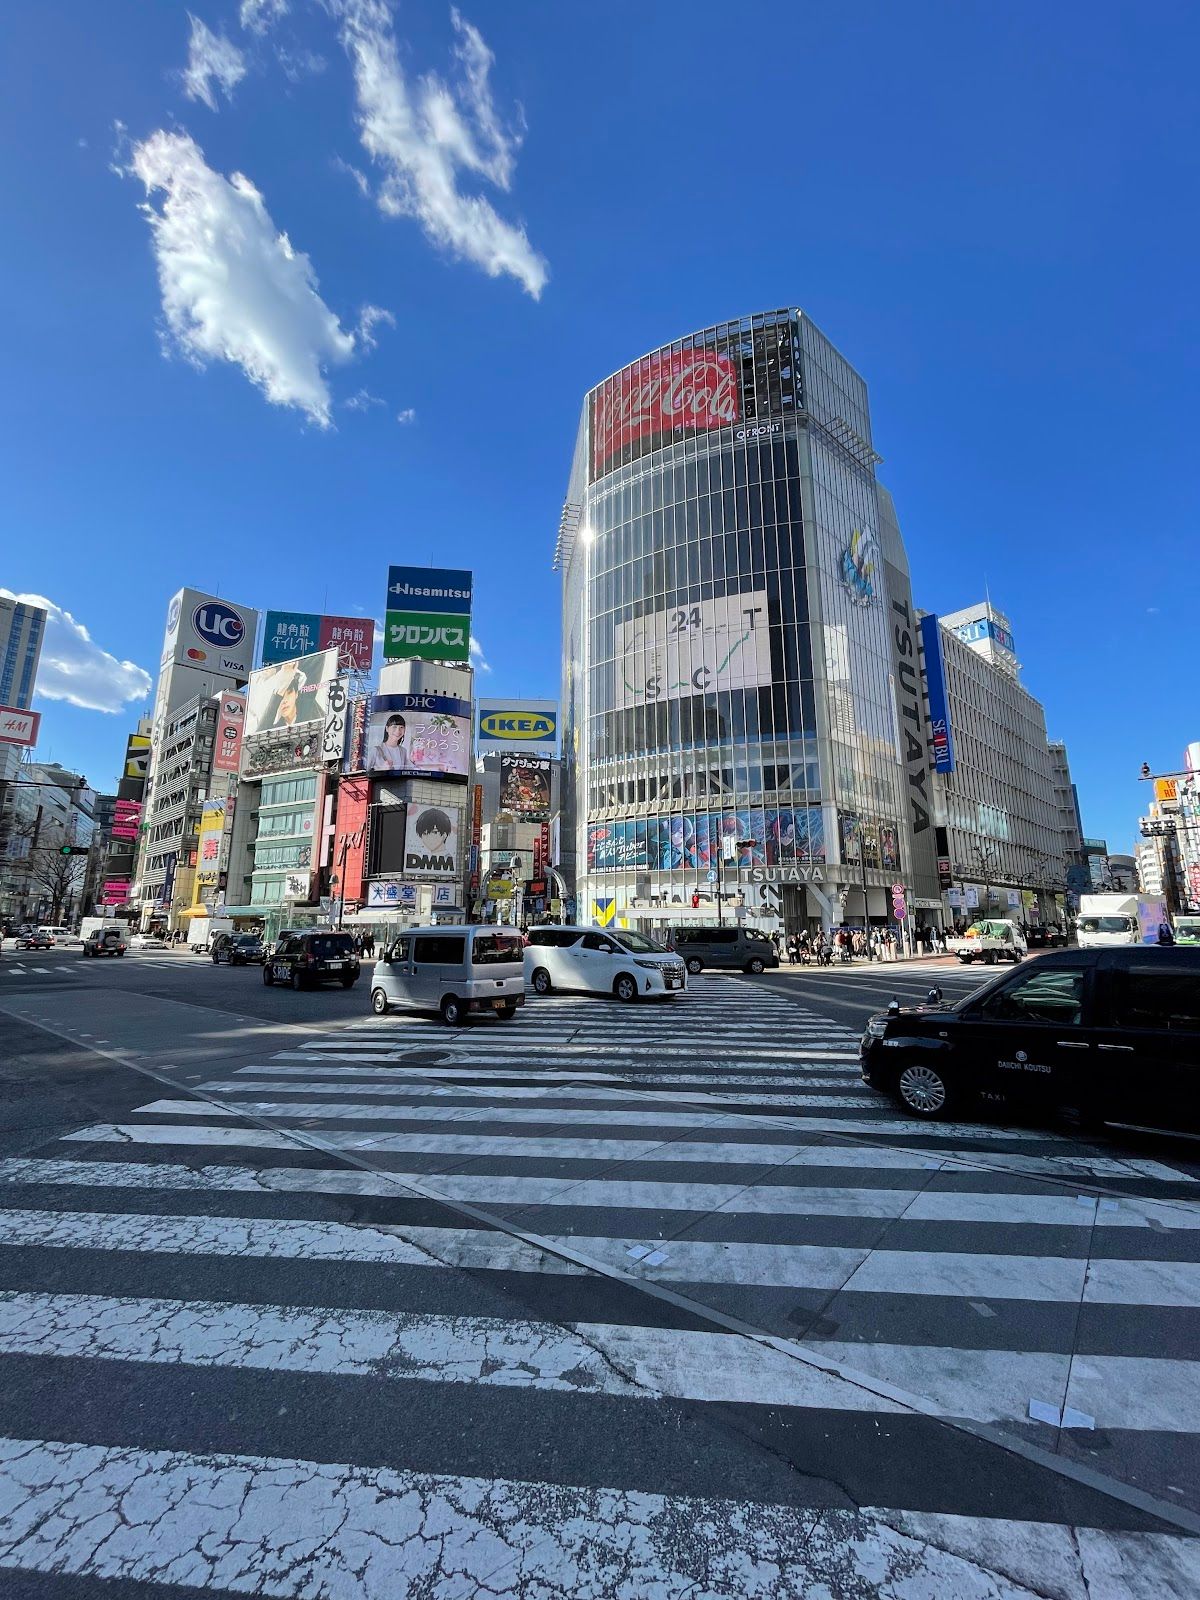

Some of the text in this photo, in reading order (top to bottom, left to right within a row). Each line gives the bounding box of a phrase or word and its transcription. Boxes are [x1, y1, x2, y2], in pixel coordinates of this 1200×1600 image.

[737, 423, 780, 440] QFRONT
[389, 583, 470, 598] Hisamitsu
[200, 609, 240, 640] UC
[669, 607, 701, 633] 24
[743, 608, 761, 631] T
[277, 623, 309, 637] 龍角散
[332, 627, 364, 641] 龍角散
[390, 625, 464, 646] サロンパス
[223, 660, 244, 671] VISA
[692, 666, 710, 690] C
[405, 696, 436, 708] DHC
[323, 679, 346, 758] もんじゃ
[488, 719, 549, 731] IKEA
[892, 599, 930, 834] TSUTAYA
[932, 719, 949, 765] SEIBU
[406, 854, 454, 871] DMM
[741, 867, 823, 882] TSUTAYA
[998, 1061, 1051, 1073] DAIICHI KOUTSU
[980, 1091, 1005, 1101] TAXI
